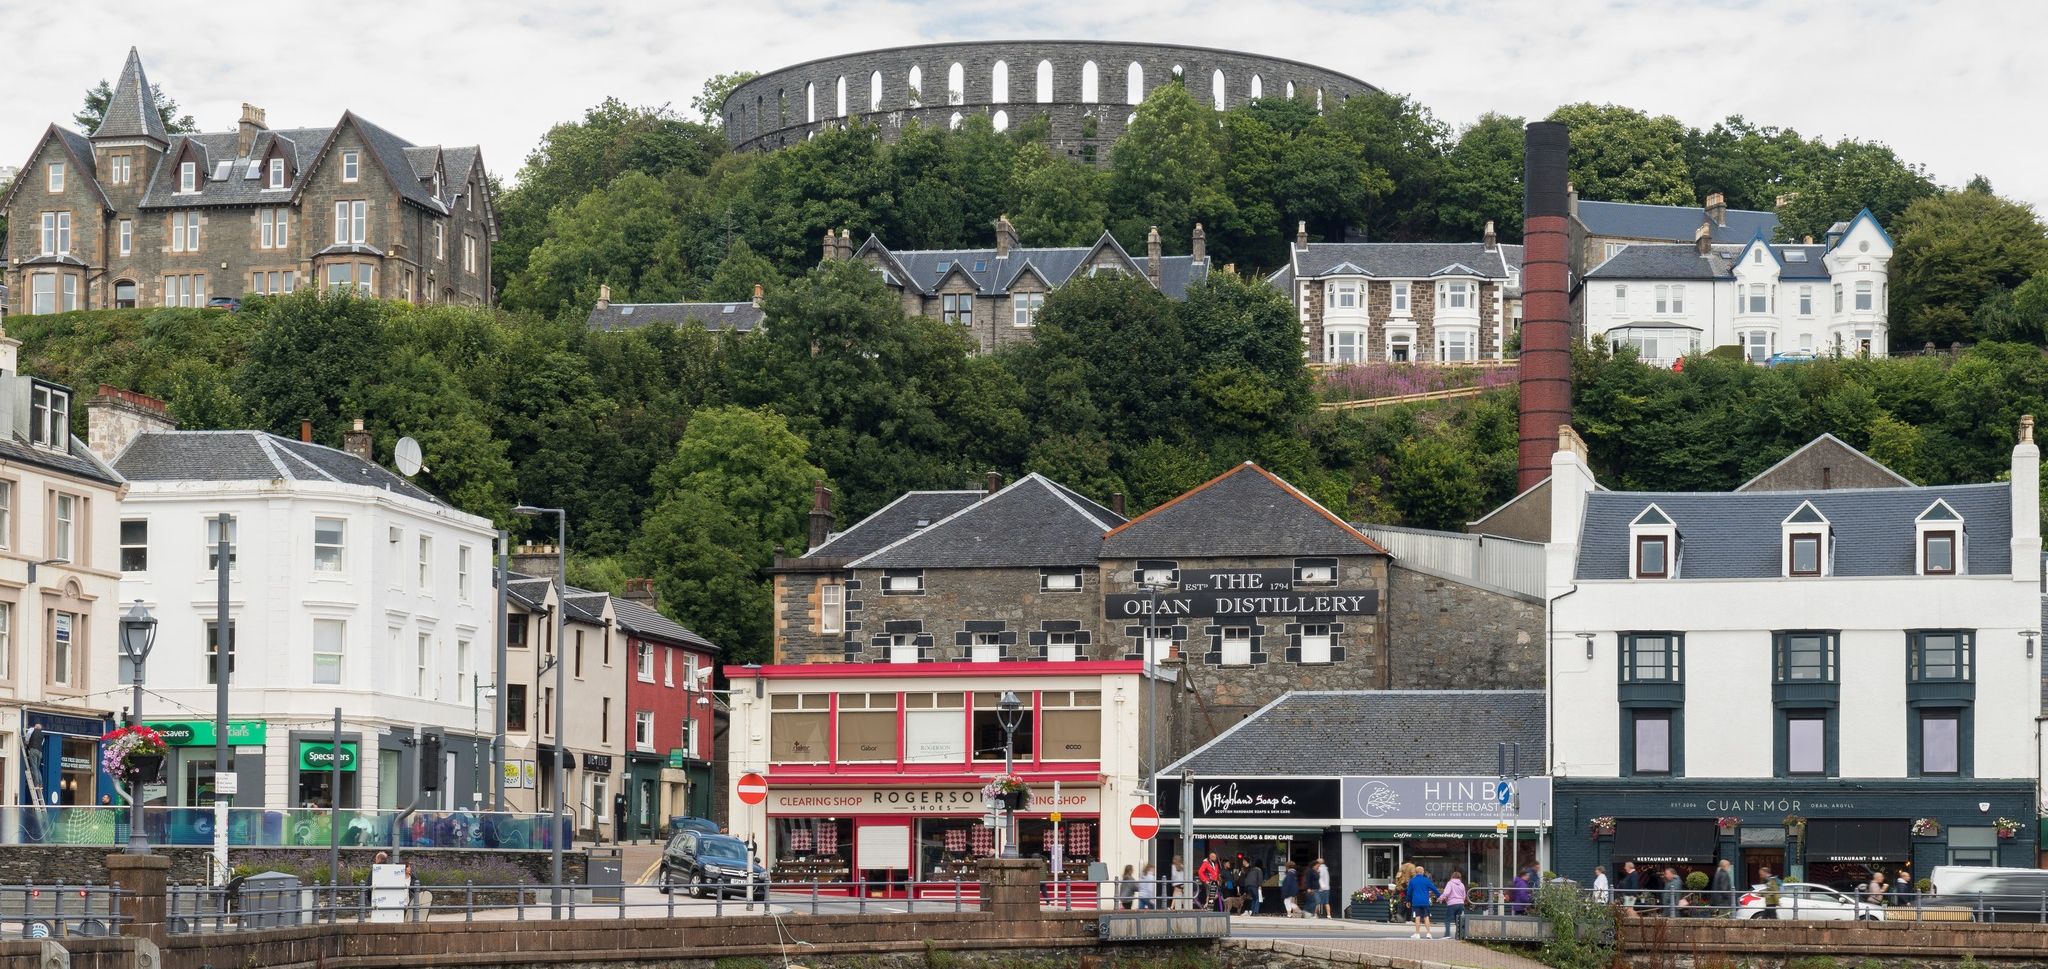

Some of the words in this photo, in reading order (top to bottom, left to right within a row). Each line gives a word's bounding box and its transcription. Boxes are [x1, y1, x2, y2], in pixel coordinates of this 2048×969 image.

[1210, 573, 1264, 590] THE
[1270, 582, 1289, 590] 1794
[1123, 599, 1192, 615] OBAN
[1215, 596, 1365, 614] DISTILLERY
[309, 751, 350, 762] Specsaers
[779, 797, 831, 806] CLEARING
[834, 797, 863, 806] SHOP
[874, 792, 983, 803] ROGERSO
[1213, 782, 1254, 810] Highland
[1255, 794, 1279, 809] Soap
[1281, 795, 1296, 805] Co.
[1425, 802, 1464, 812] COFFEE
[1466, 802, 1516, 812] ROASTR
